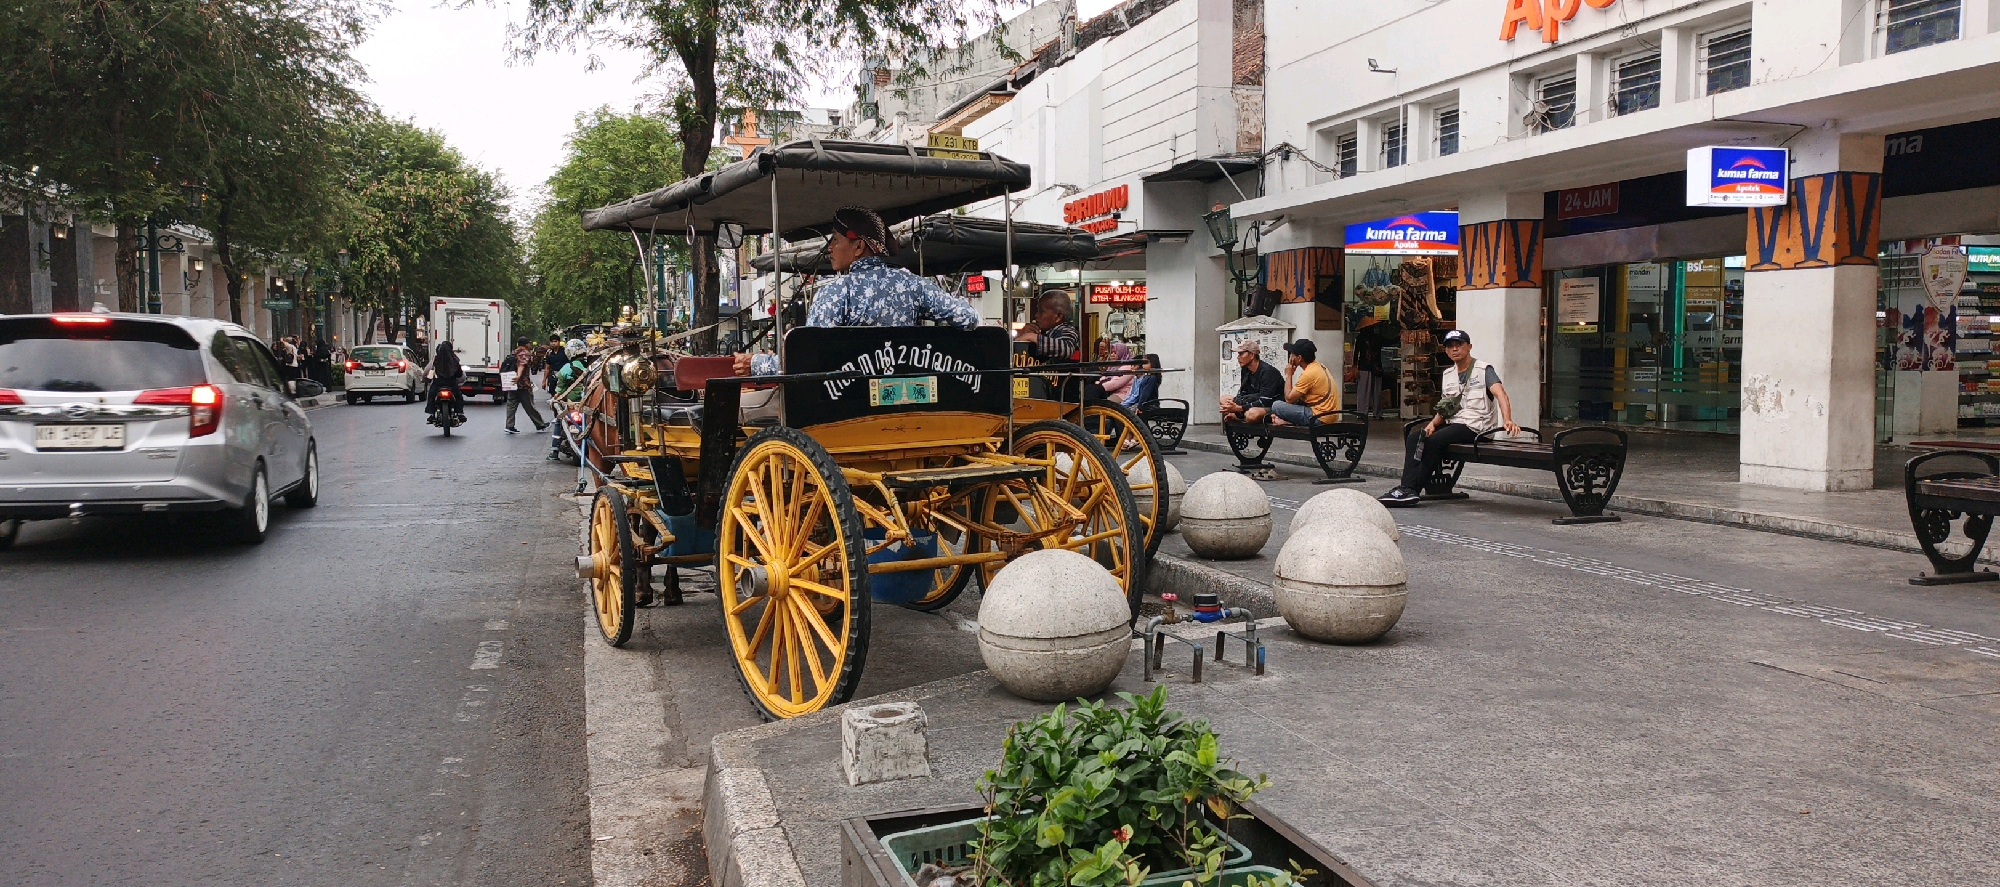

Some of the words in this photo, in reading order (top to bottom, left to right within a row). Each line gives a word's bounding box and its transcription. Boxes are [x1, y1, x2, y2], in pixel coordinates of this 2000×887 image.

[1499, 0, 1617, 43] Ap
[929, 135, 939, 146] YK
[945, 137, 958, 148] 231
[962, 139, 978, 150] KTB
[1717, 168, 1747, 178] kimia
[1748, 168, 1779, 179] farma
[1735, 184, 1760, 193] Apotek
[1565, 192, 1581, 211] 24
[1584, 188, 1612, 208] JAM
[1365, 227, 1404, 240] kimia
[1405, 227, 1447, 240] farma
[1393, 241, 1419, 249] Apotek
[1687, 261, 1703, 272] BSI
